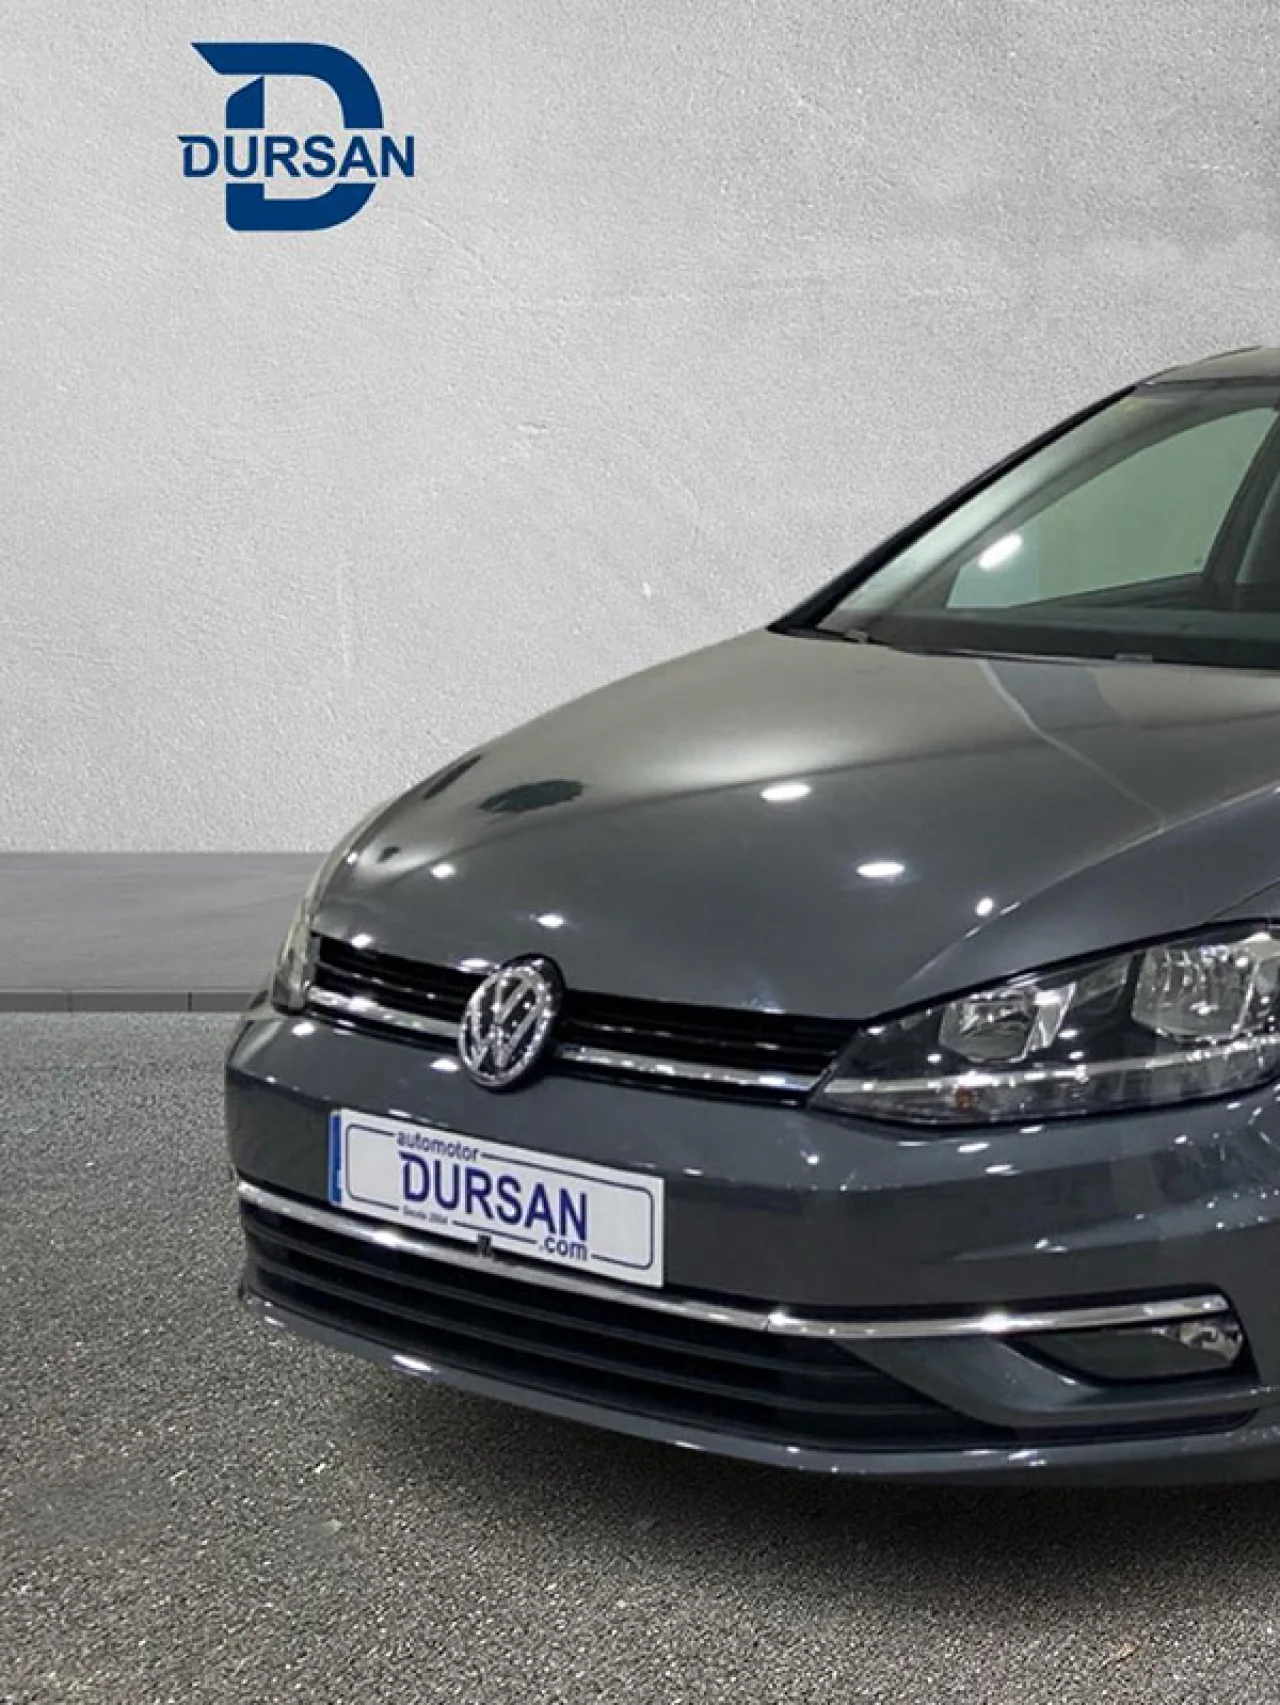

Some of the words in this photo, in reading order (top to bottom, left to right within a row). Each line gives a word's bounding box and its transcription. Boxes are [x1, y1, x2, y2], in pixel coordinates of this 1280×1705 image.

[396, 1132, 479, 1162] automotor
[398, 1151, 588, 1241] DURSAN
[539, 1233, 588, 1261] .com
